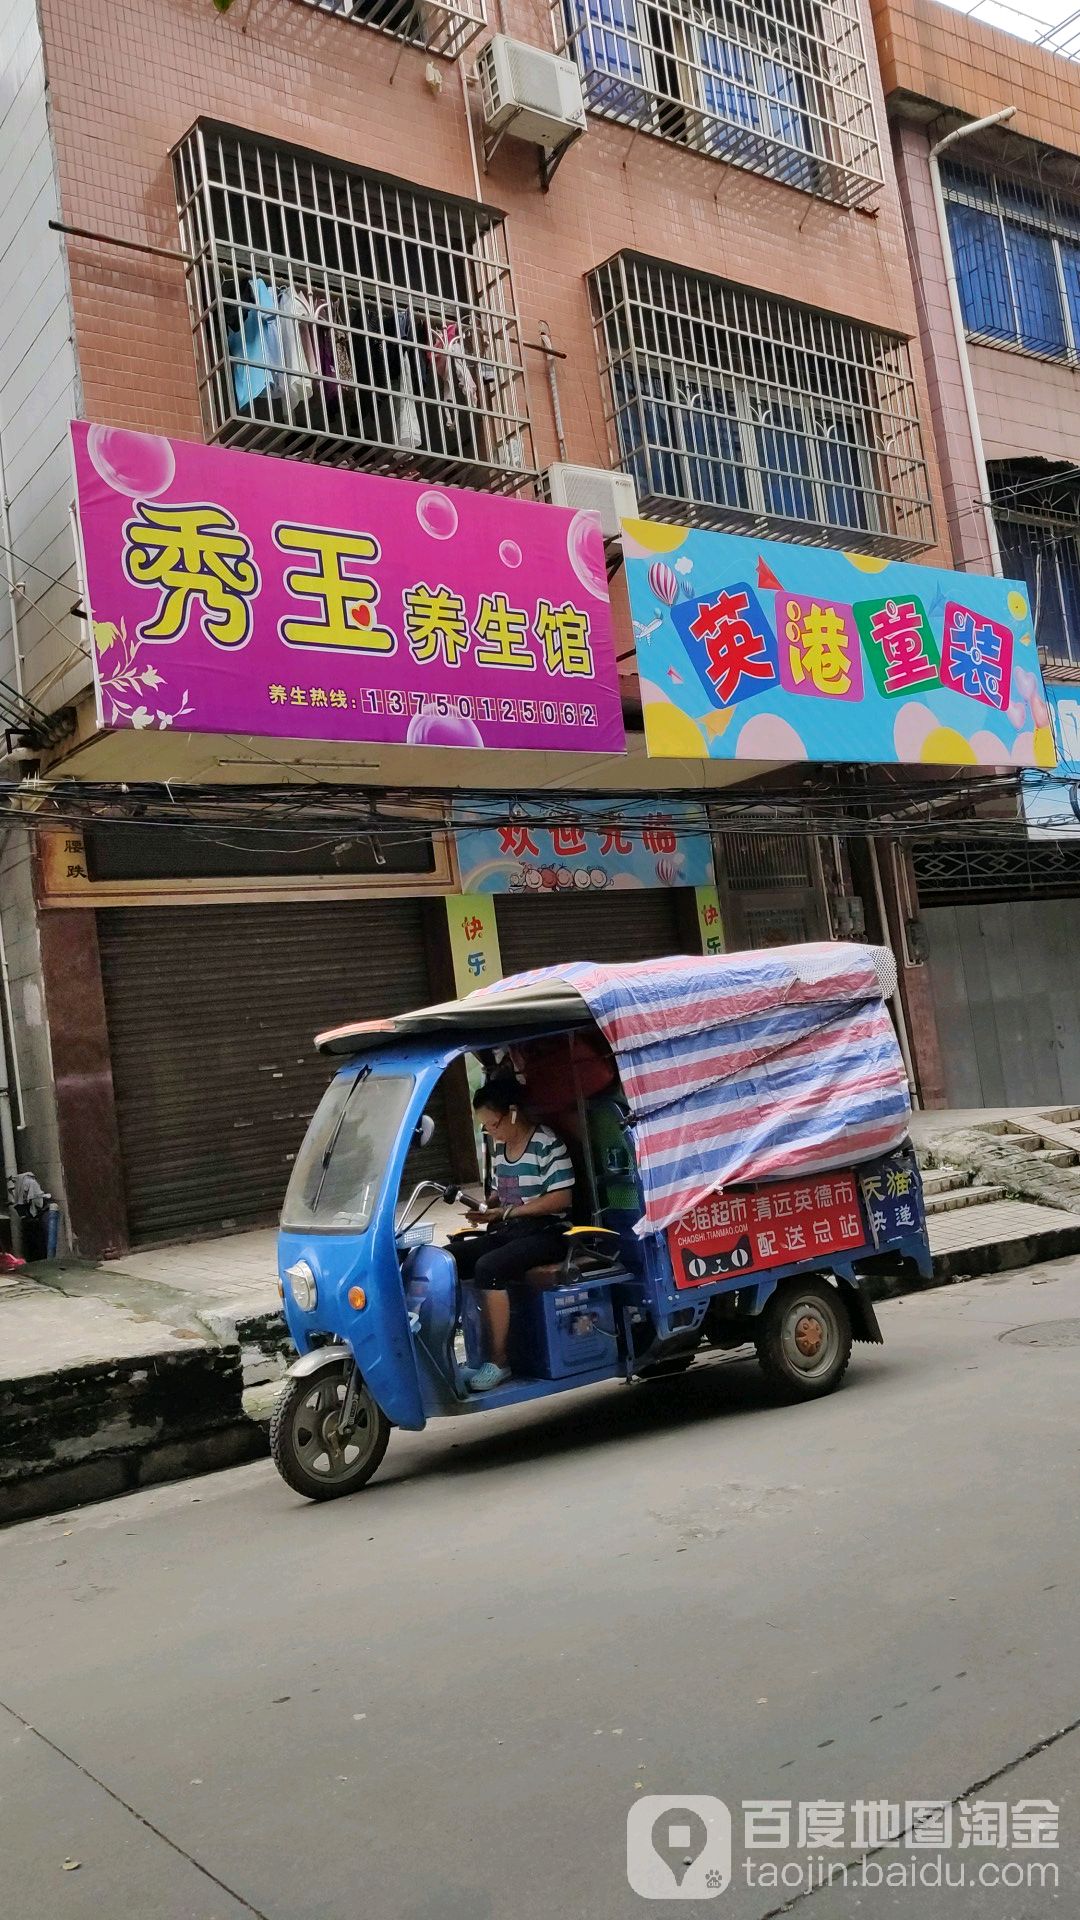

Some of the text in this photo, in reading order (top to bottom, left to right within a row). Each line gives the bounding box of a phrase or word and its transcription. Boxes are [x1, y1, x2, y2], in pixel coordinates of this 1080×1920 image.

[402, 581, 594, 678] 养生馆
[690, 590, 1005, 710] 英港童装
[460, 915, 488, 977] 快乐
[751, 1181, 853, 1222] 清远英德市
[756, 1213, 860, 1258] 配送总站
